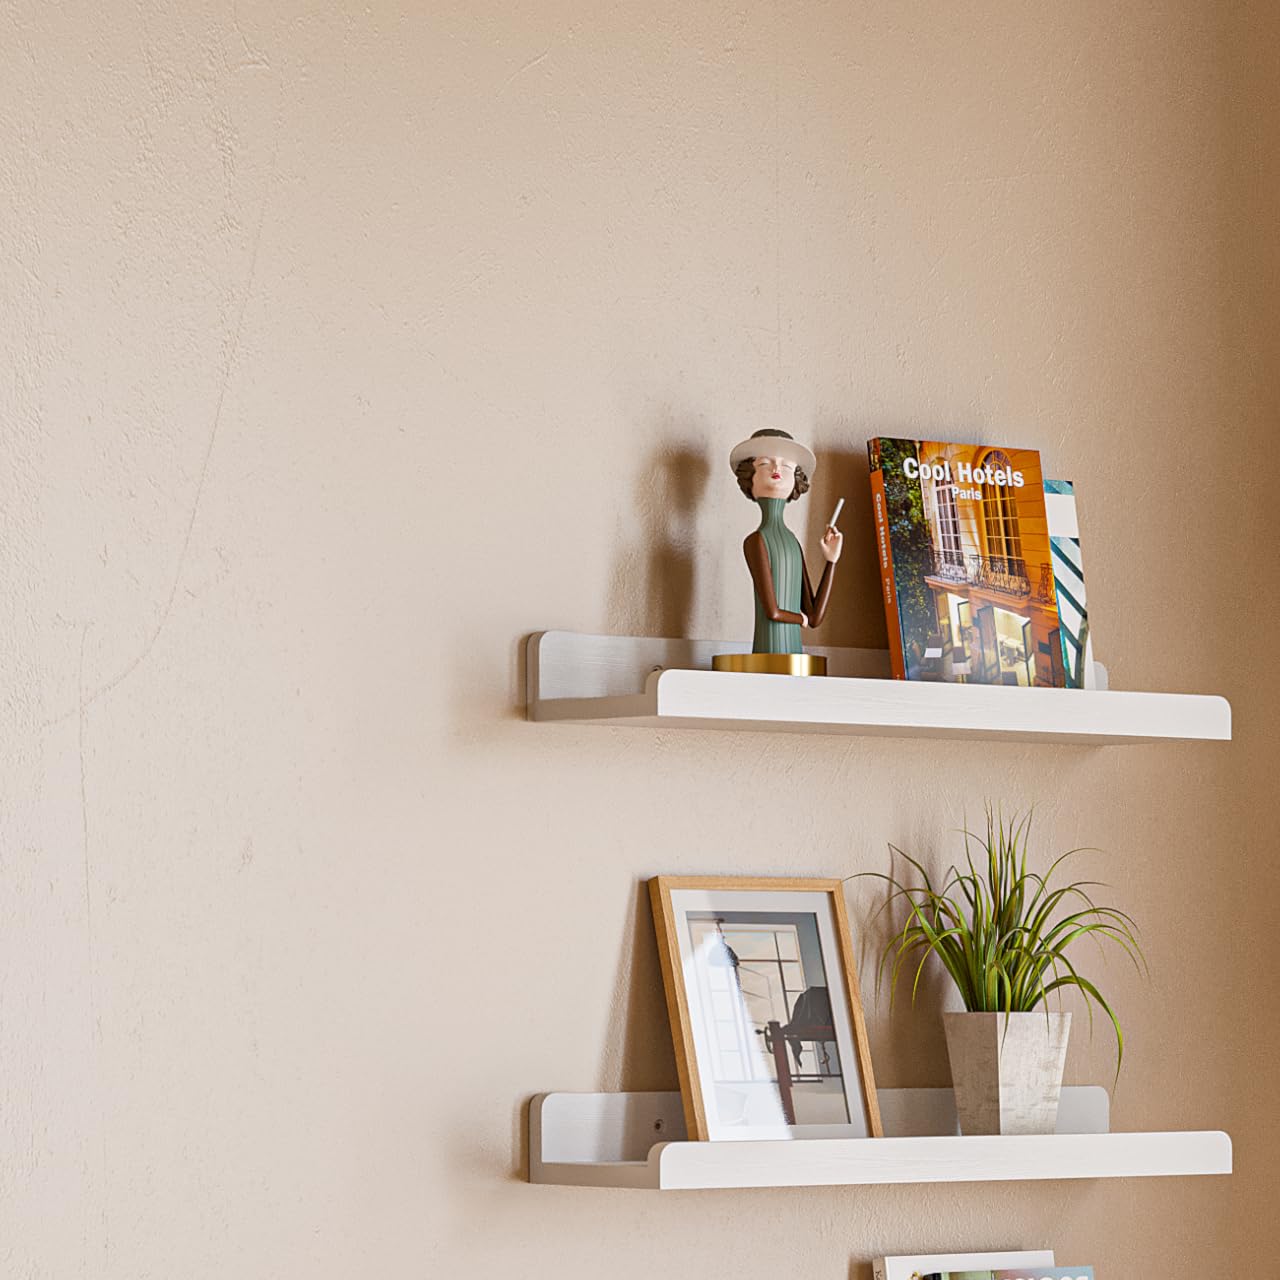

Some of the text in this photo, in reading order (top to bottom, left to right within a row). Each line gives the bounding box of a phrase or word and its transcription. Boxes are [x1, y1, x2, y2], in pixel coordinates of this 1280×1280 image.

[903, 457, 1025, 488] Cool Hotels
[952, 486, 982, 500] Paris
